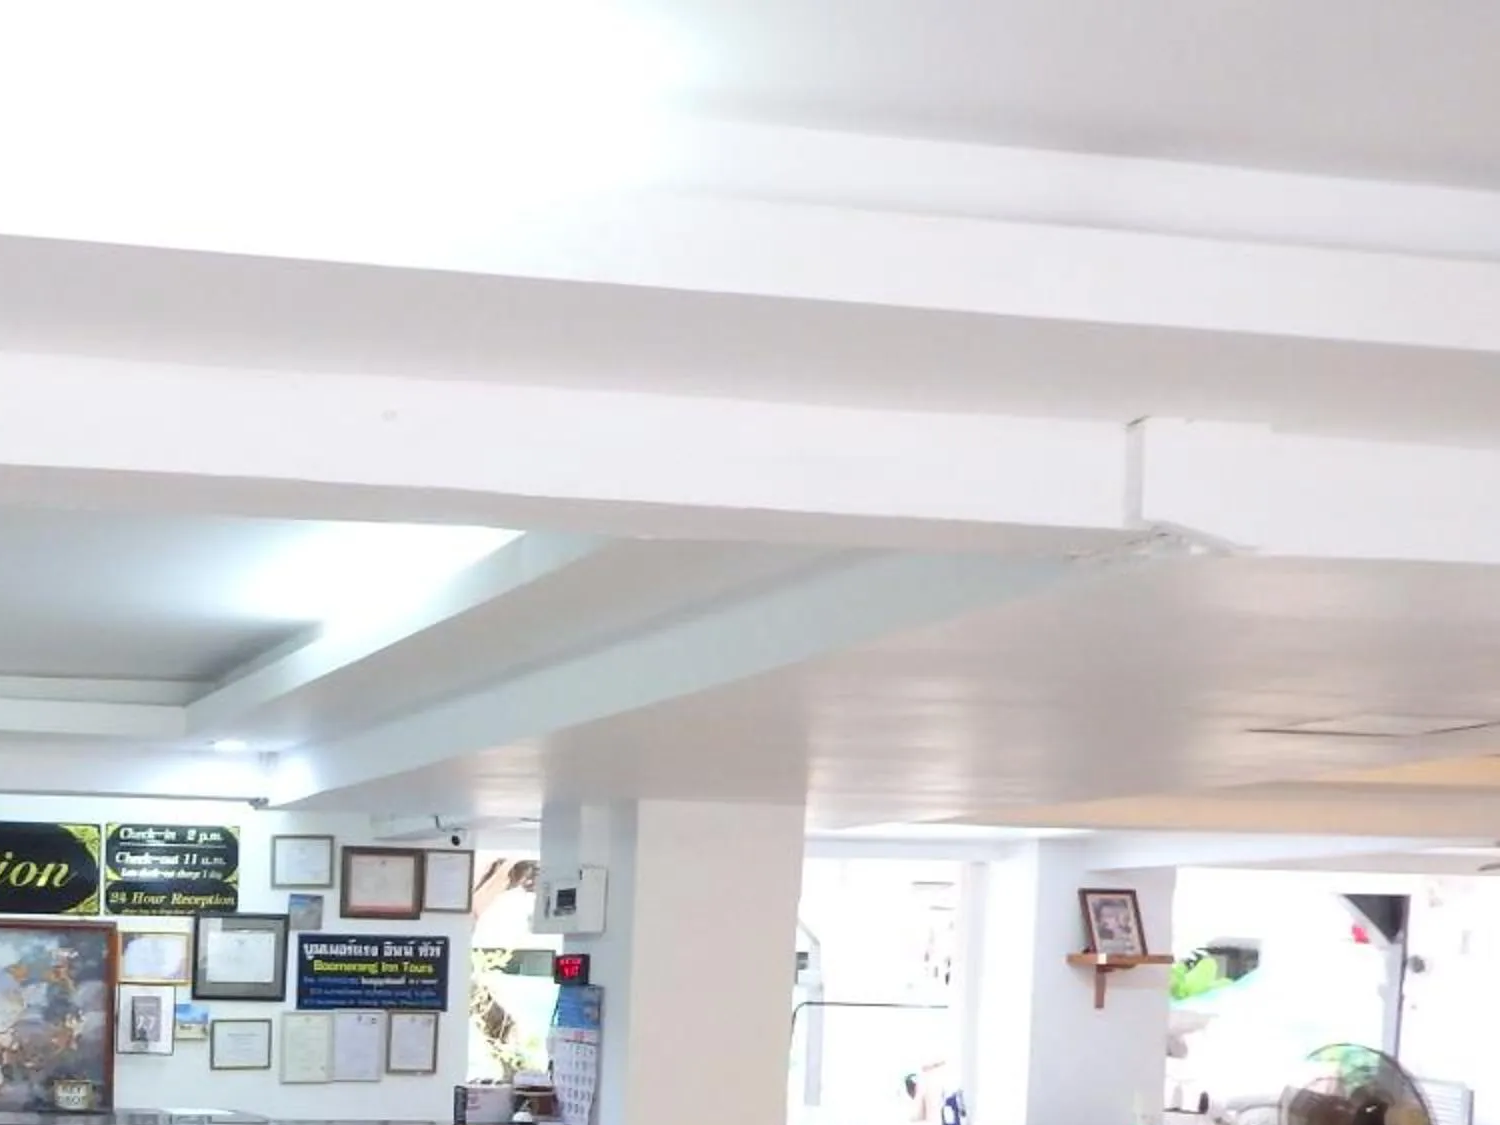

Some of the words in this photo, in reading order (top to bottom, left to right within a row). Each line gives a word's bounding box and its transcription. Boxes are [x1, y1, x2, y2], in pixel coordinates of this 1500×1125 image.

[120, 827, 177, 841] Check-in
[115, 851, 180, 865] Check-out
[183, 853, 198, 865] 11
[131, 891, 168, 905] Hour
[171, 892, 235, 908] Reception
[313, 960, 379, 975] Boomerang
[381, 961, 399, 973] Inn
[403, 961, 435, 974] Tours
